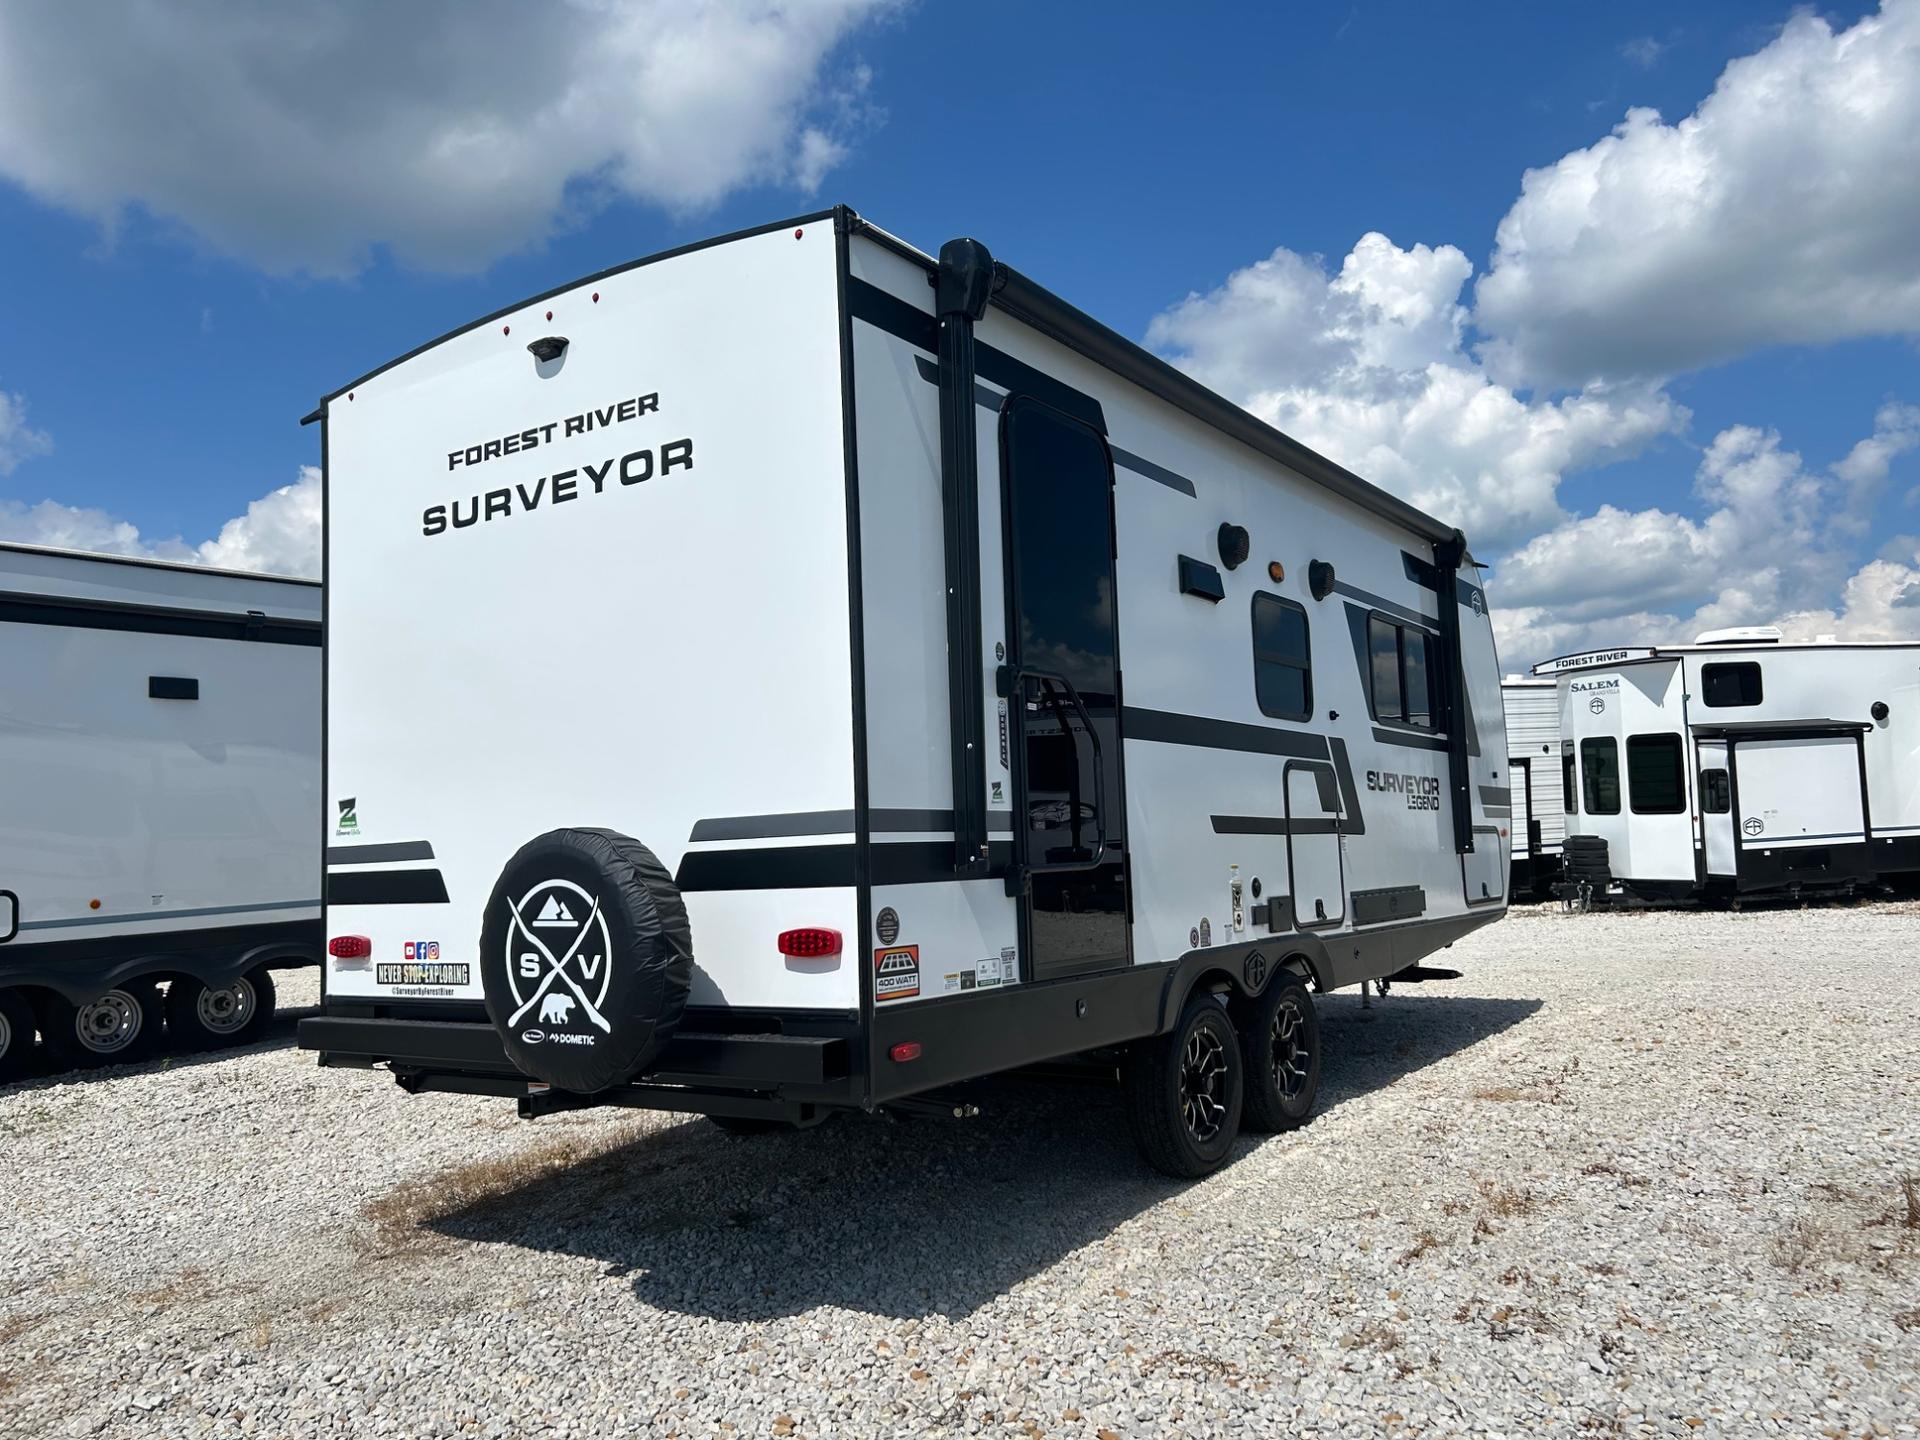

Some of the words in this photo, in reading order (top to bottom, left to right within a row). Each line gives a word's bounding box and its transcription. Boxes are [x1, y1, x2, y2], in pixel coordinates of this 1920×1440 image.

[448, 421, 558, 472] FOREST
[564, 391, 660, 438] RIVER
[422, 437, 694, 537] SURVEYOR
[1556, 656, 1594, 668] FOREST
[1596, 651, 1627, 662] RIVER
[1571, 679, 1619, 692] SALEM
[1366, 770, 1440, 796] SURVEYOR
[1406, 794, 1440, 811] LEGEND
[378, 964, 402, 983] NEVER
[403, 964, 423, 983] STOP
[423, 964, 468, 983] EXPLORING
[520, 952, 540, 978] S
[577, 954, 601, 979] V
[878, 978, 895, 987] 400
[895, 974, 917, 985] WATT
[560, 1033, 595, 1046] DOMETIC
